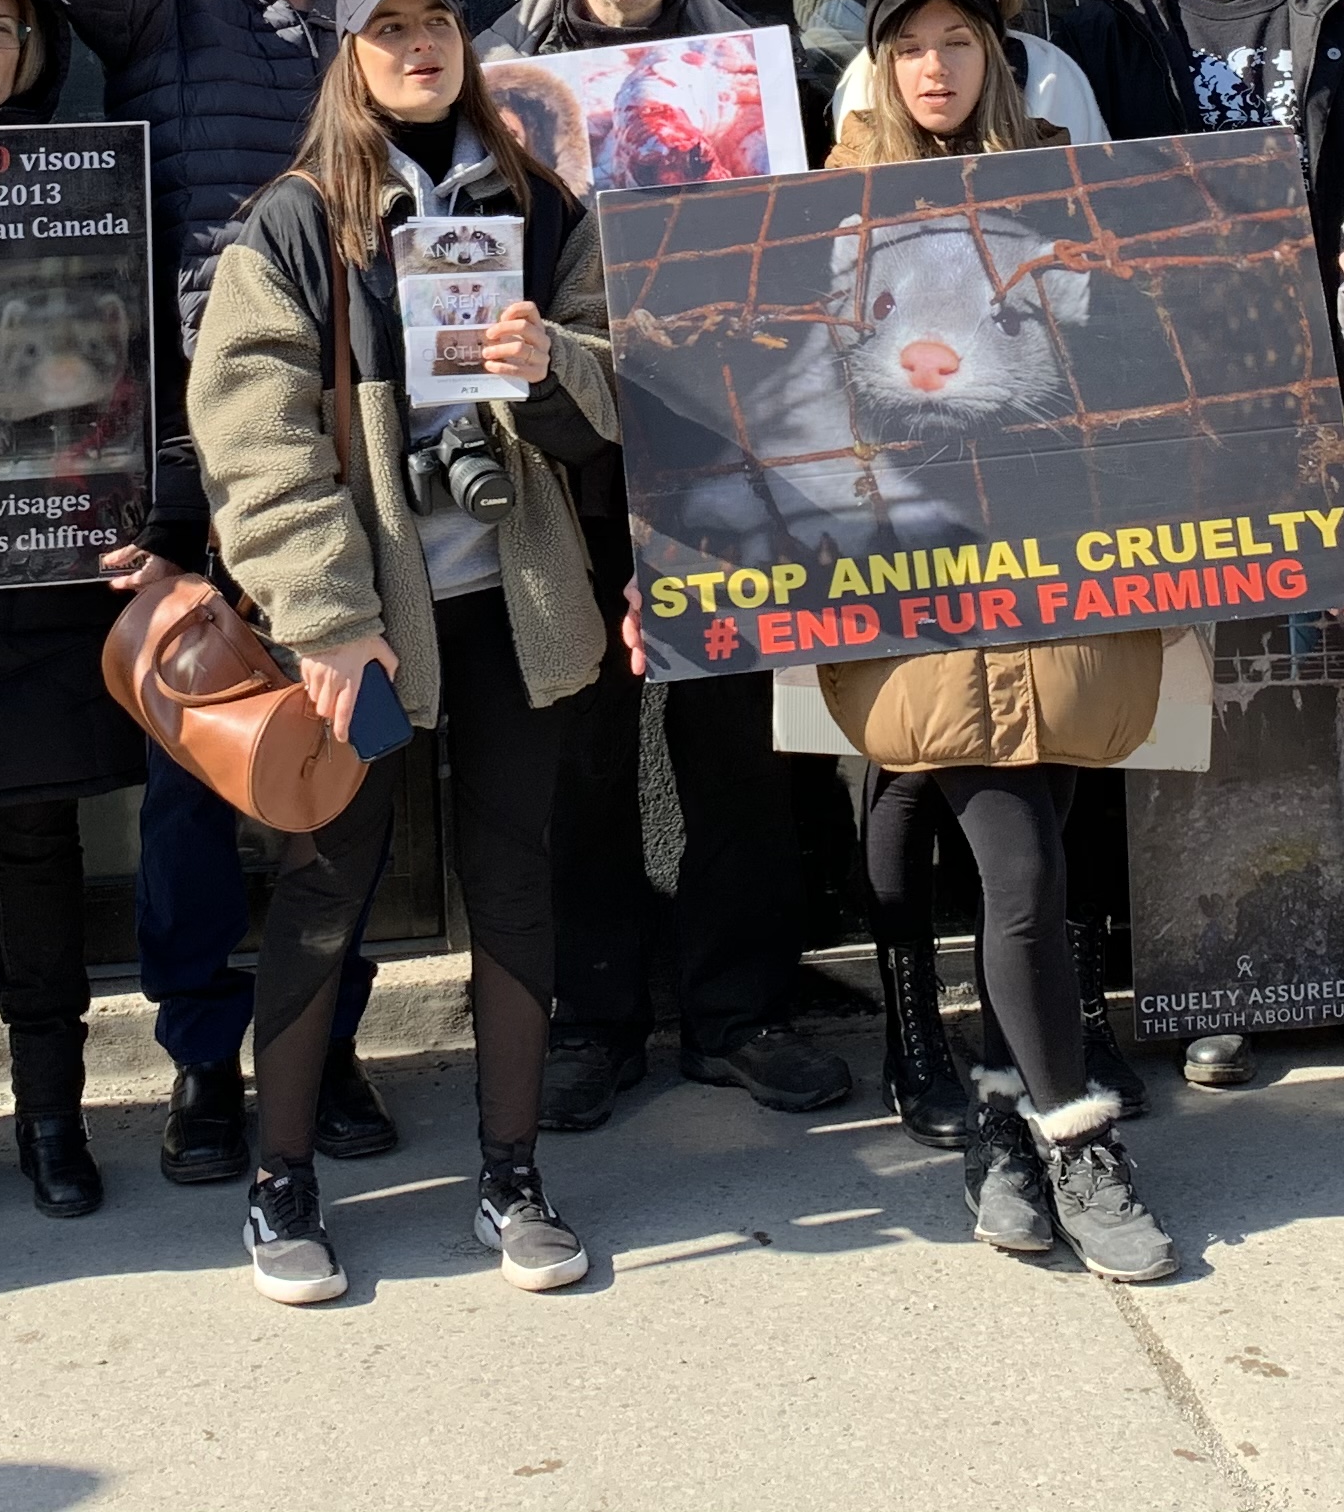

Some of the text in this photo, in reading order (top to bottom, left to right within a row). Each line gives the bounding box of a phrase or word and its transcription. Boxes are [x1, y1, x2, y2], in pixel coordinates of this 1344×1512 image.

[19, 147, 116, 172] visons
[32, 213, 130, 238] Canada
[422, 241, 506, 258] ANIMALS
[422, 345, 483, 363] CLOTH
[16, 525, 117, 551] chiffres
[652, 563, 806, 619] STOP
[828, 538, 1059, 599] ANIMAL
[758, 606, 880, 655] END
[899, 588, 1021, 638] FUR
[1038, 558, 1308, 624] FARMING
[1141, 989, 1240, 1014] CRUELTY
[1143, 1018, 1179, 1034] THE
[1184, 1012, 1246, 1031] TRUTH
[1252, 1005, 1316, 1026] ABOUT
